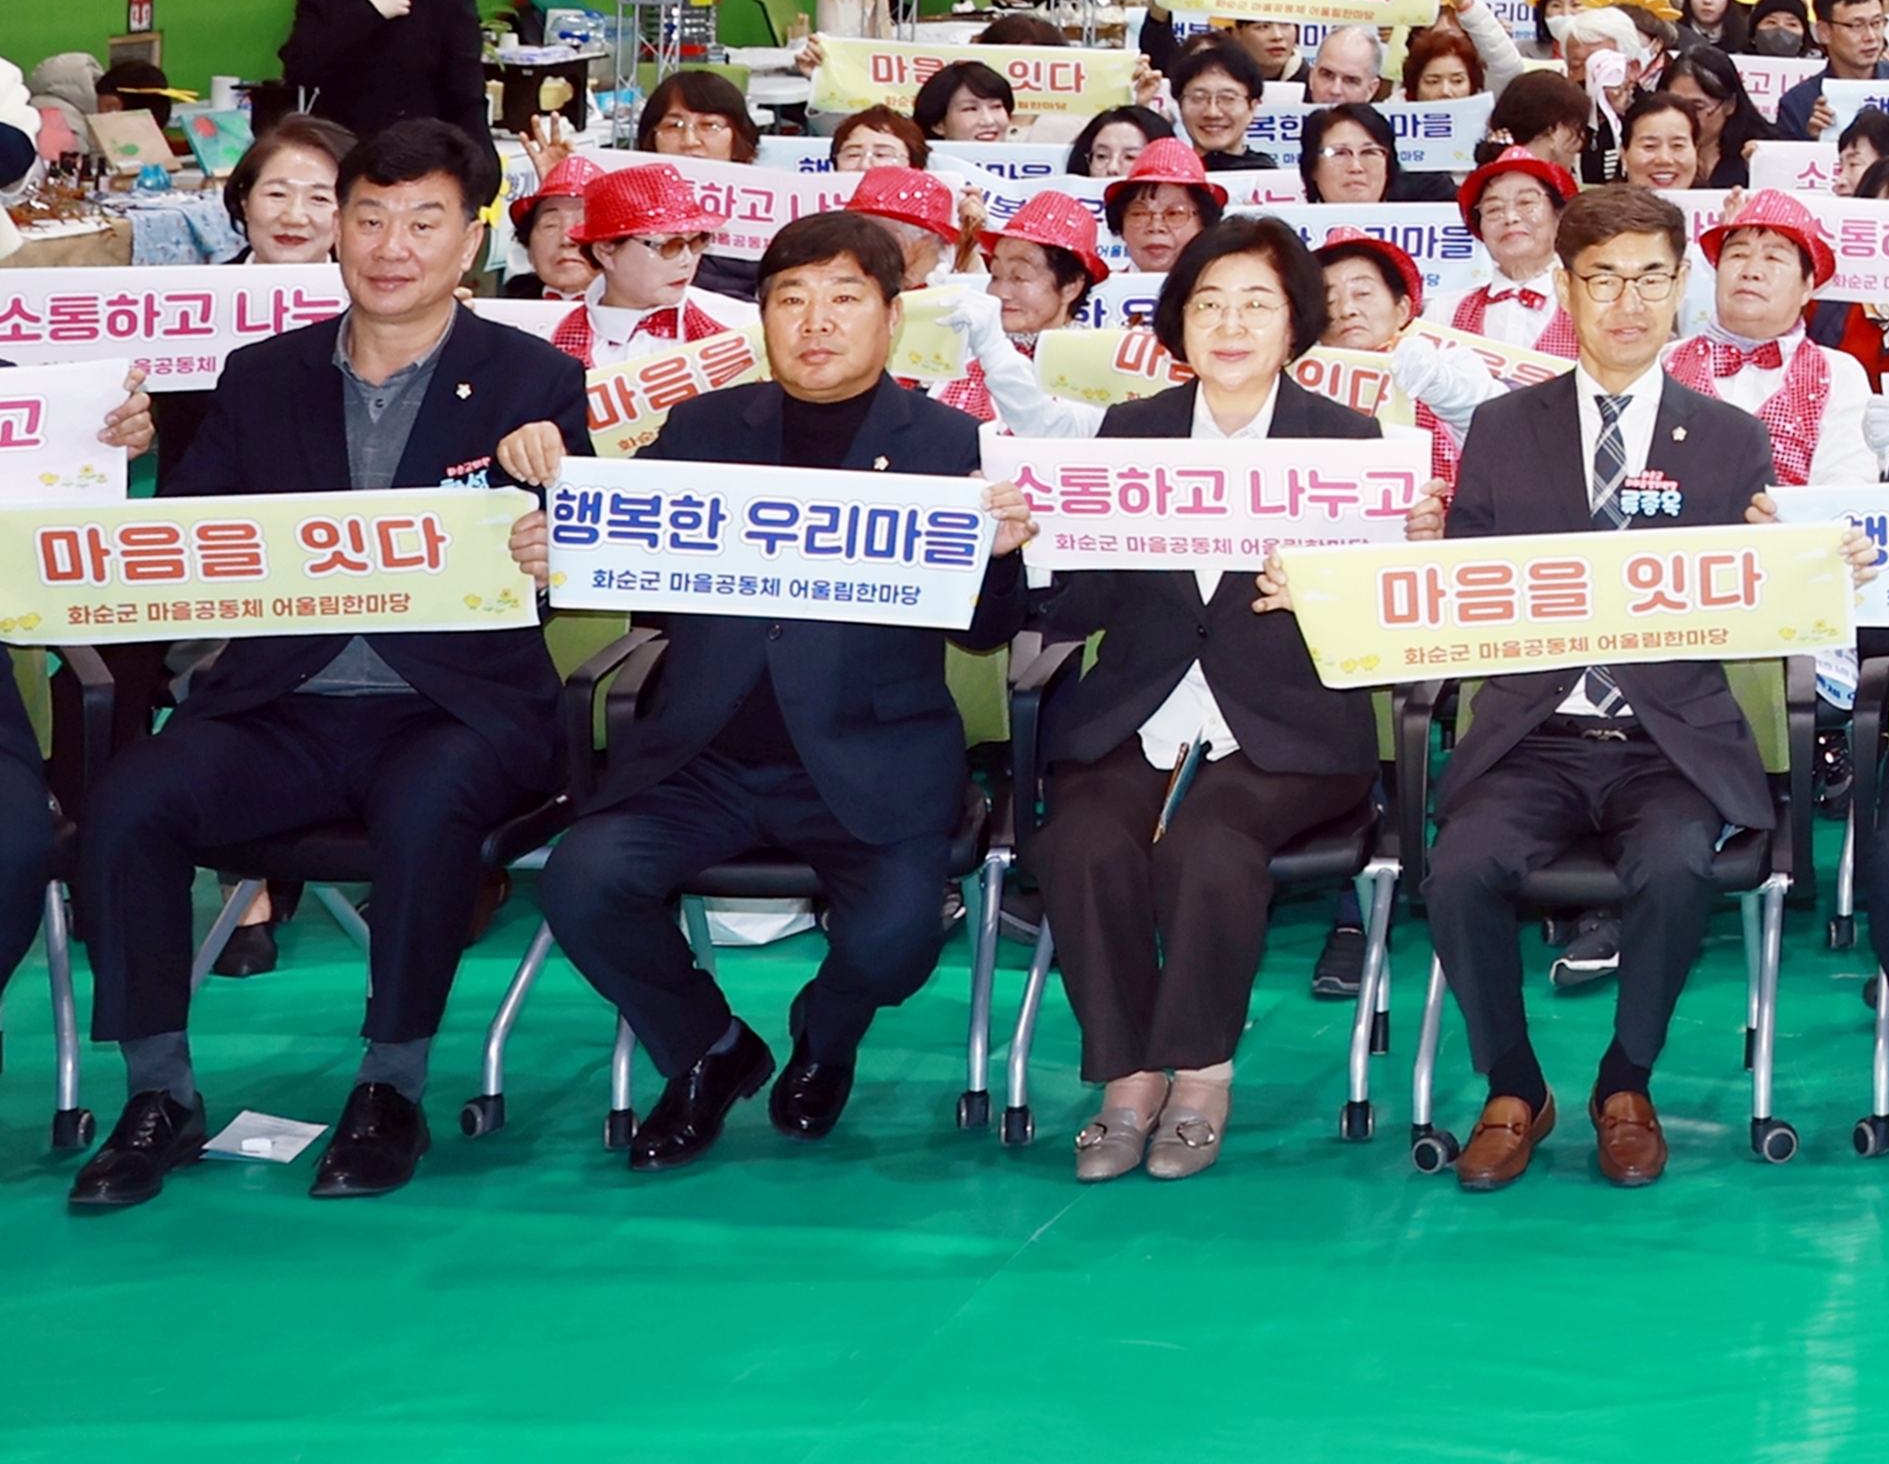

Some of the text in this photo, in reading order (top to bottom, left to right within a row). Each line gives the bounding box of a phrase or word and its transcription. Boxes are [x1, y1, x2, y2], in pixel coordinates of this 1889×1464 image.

[1493, 1, 1538, 26] 우리마
[1008, 60, 1086, 93] 잇다
[1247, 112, 1452, 142] 복한 마을
[1832, 273, 1877, 291] 화순군
[0, 294, 214, 341] 소통하고
[133, 356, 216, 376] 을공동체
[586, 335, 755, 431] 마음을
[1013, 466, 1418, 520] 소통하고 나누고
[1621, 489, 1681, 516] 류종옥
[552, 488, 982, 568] 행복한 우리마을
[1055, 532, 1233, 556] 화순군 마을공동체
[41, 516, 447, 586] 마음을 잇다
[591, 568, 921, 606] 화순군 마을공동체 어울림한마당
[1382, 552, 1761, 626] 마음을 잇다
[67, 592, 411, 626] 화순군 마을공동체 어울림한마당
[1404, 626, 1729, 666] 화순군 마을공동체 어울림한마당
